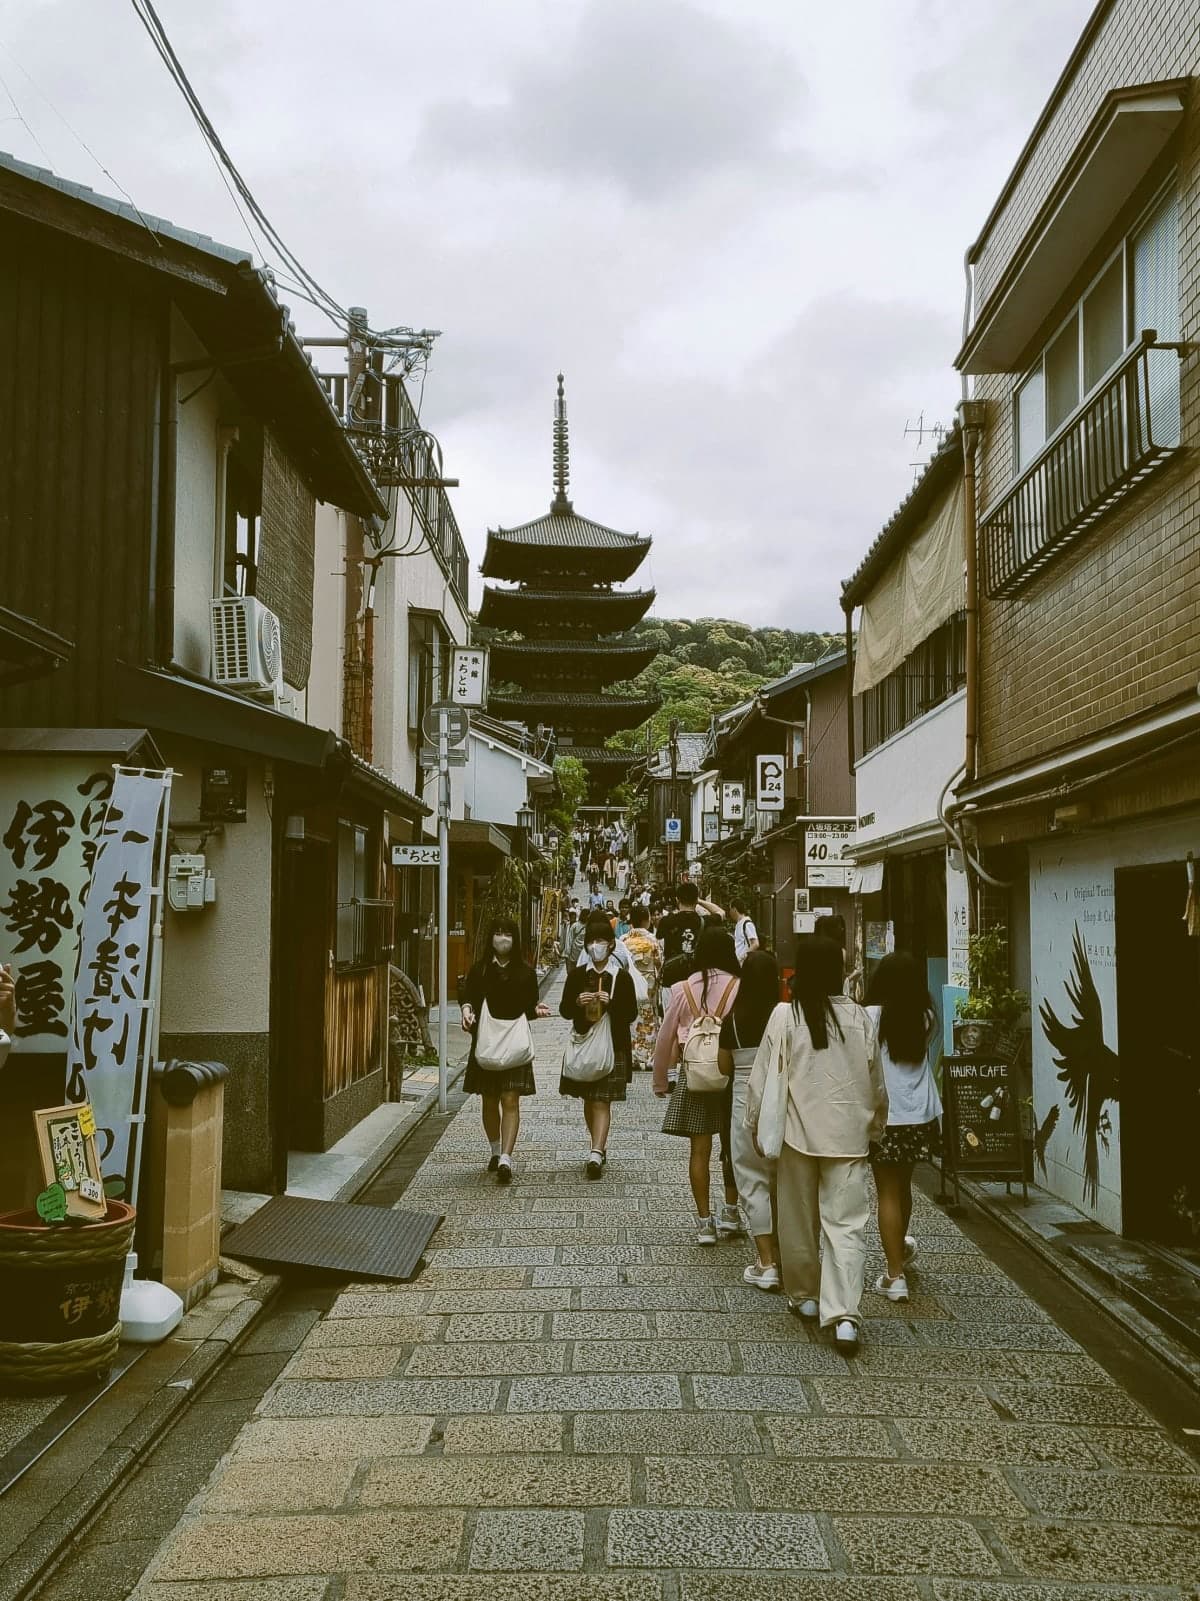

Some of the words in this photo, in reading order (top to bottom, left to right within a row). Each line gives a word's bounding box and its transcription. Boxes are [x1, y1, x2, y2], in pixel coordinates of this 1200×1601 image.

[457, 664, 468, 697] ちとせ
[768, 783, 781, 791] 24
[409, 849, 440, 863] ちとせ
[1074, 884, 1095, 901] Original
[1, 800, 75, 1038] 伊勢屋
[1083, 909, 1096, 926] Shop
[1087, 944, 1112, 957] HAUR
[980, 1065, 1008, 1078] CAFE
